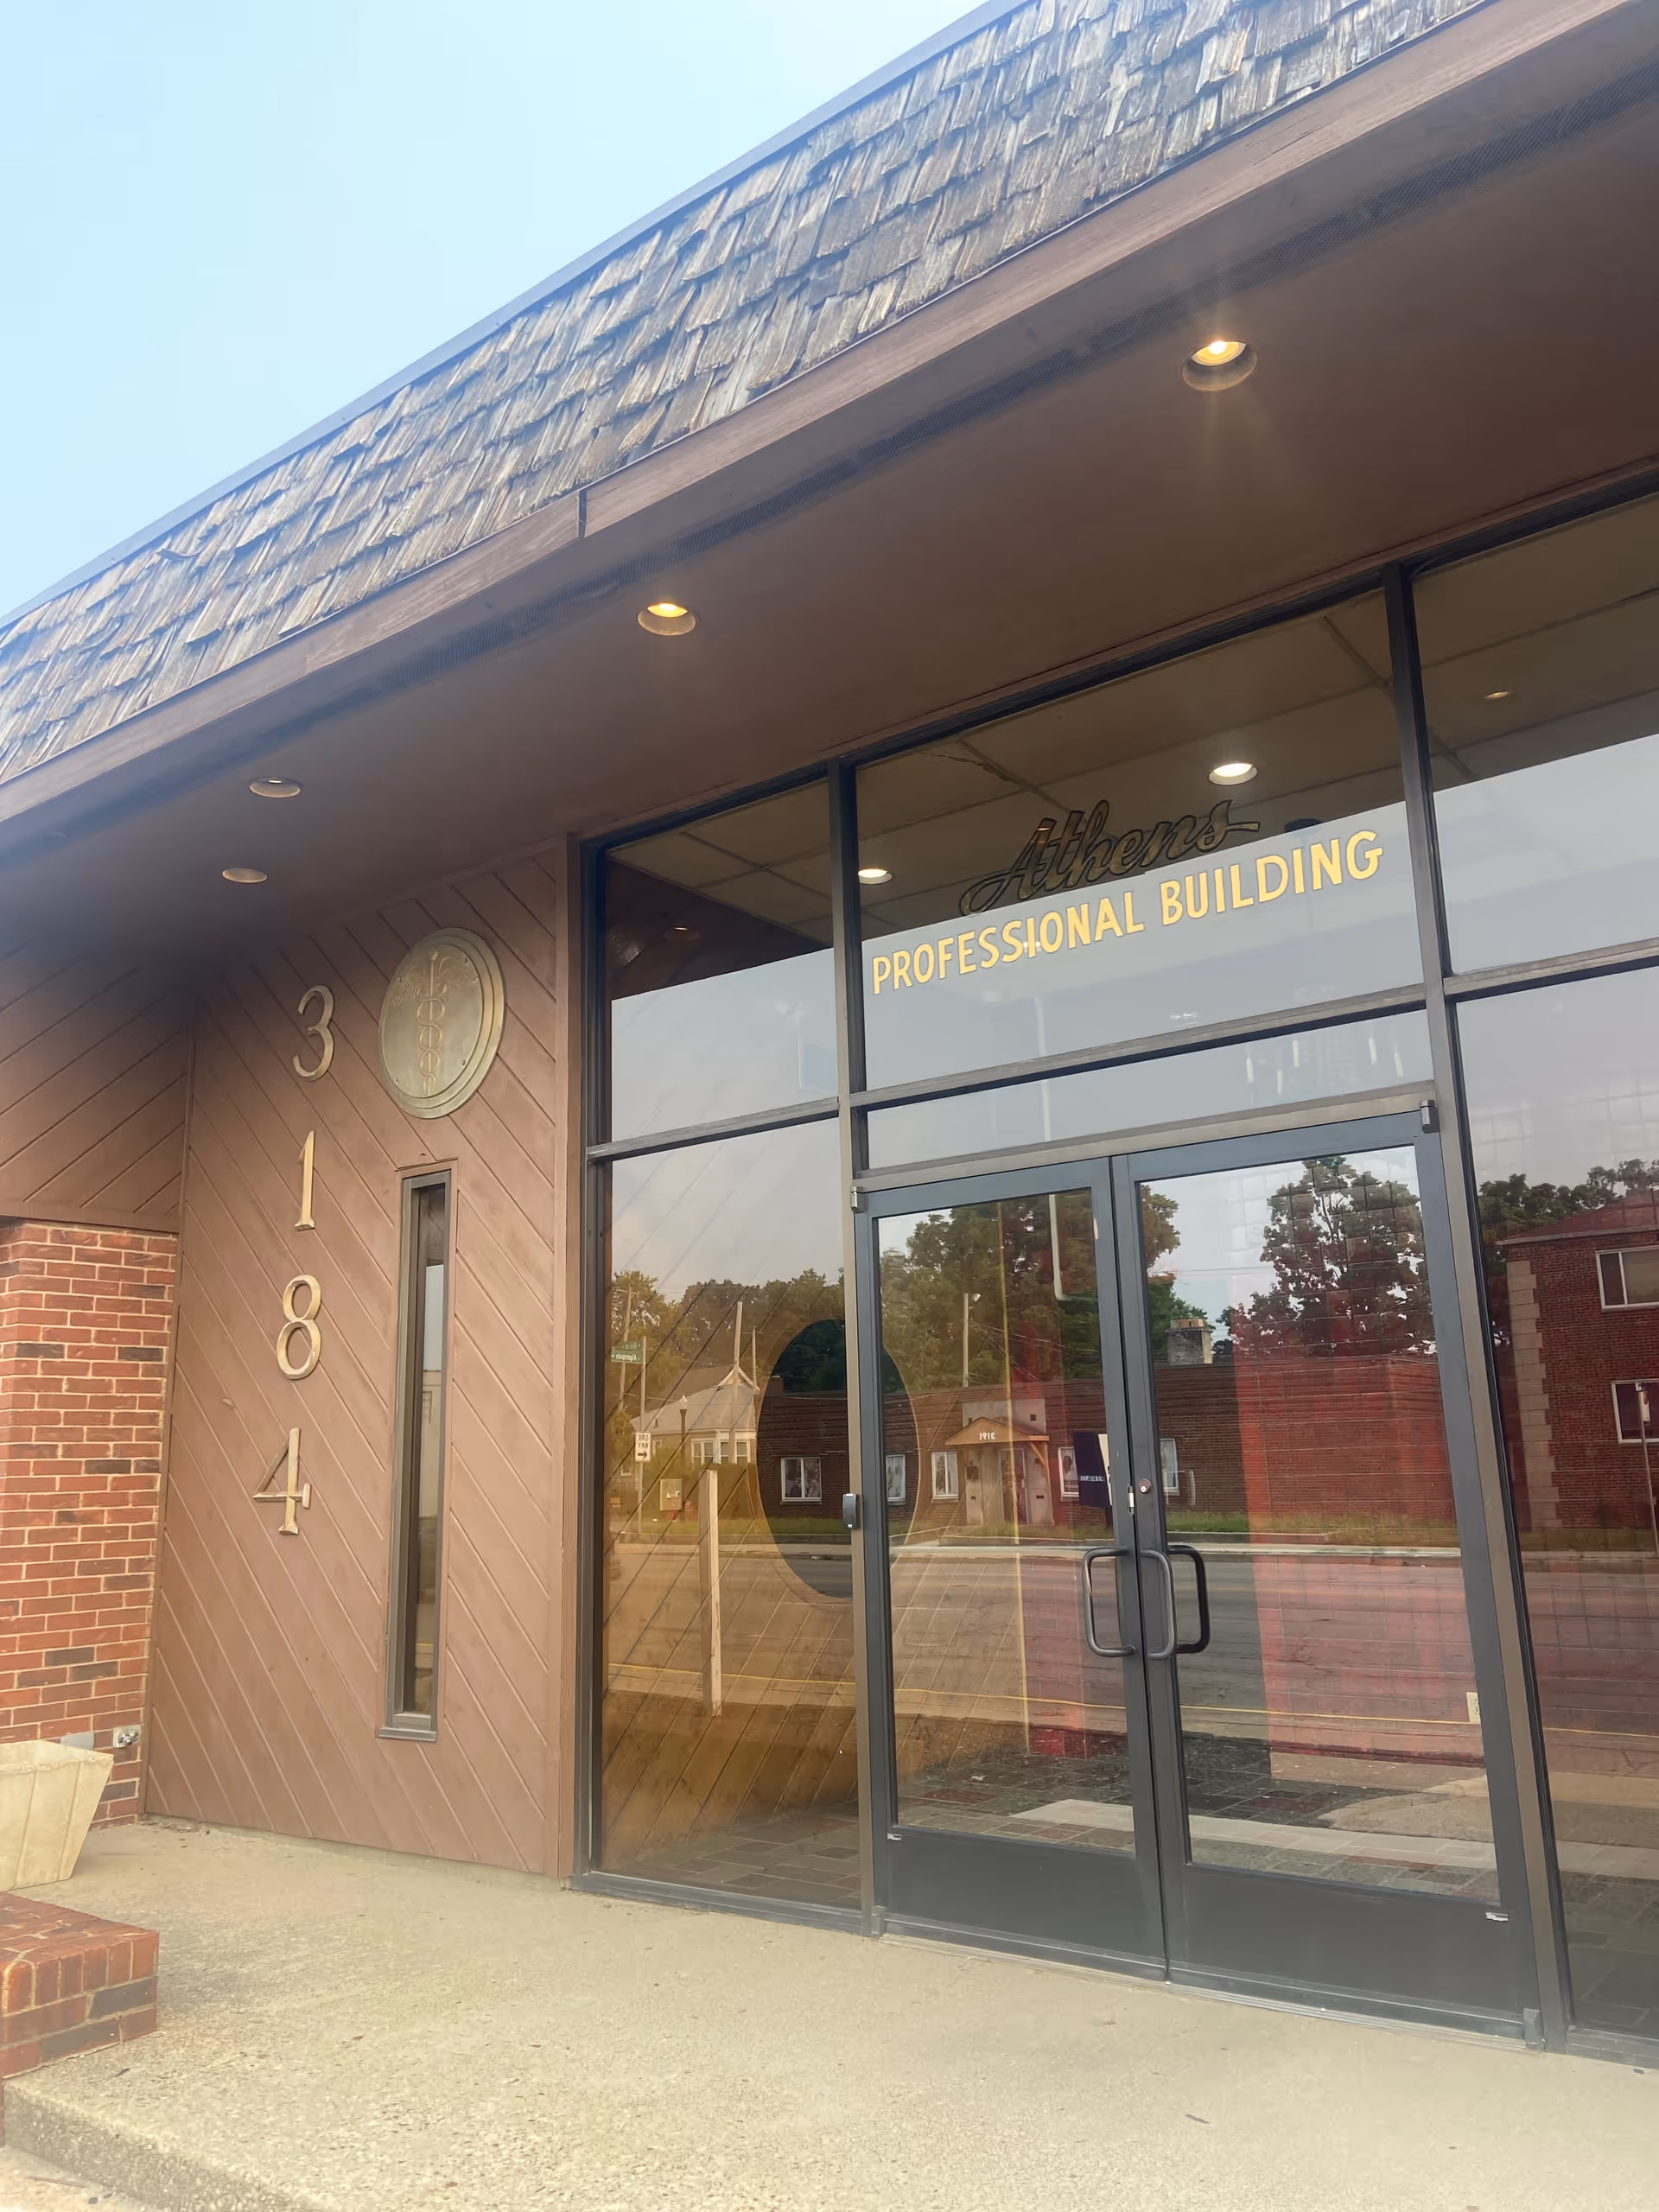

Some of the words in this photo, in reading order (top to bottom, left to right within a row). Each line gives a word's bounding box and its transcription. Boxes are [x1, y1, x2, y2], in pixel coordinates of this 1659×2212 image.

[871, 892, 1145, 995] PROFESSIONAL
[1158, 830, 1383, 926] BUILDING
[959, 798, 1261, 916] Athens
